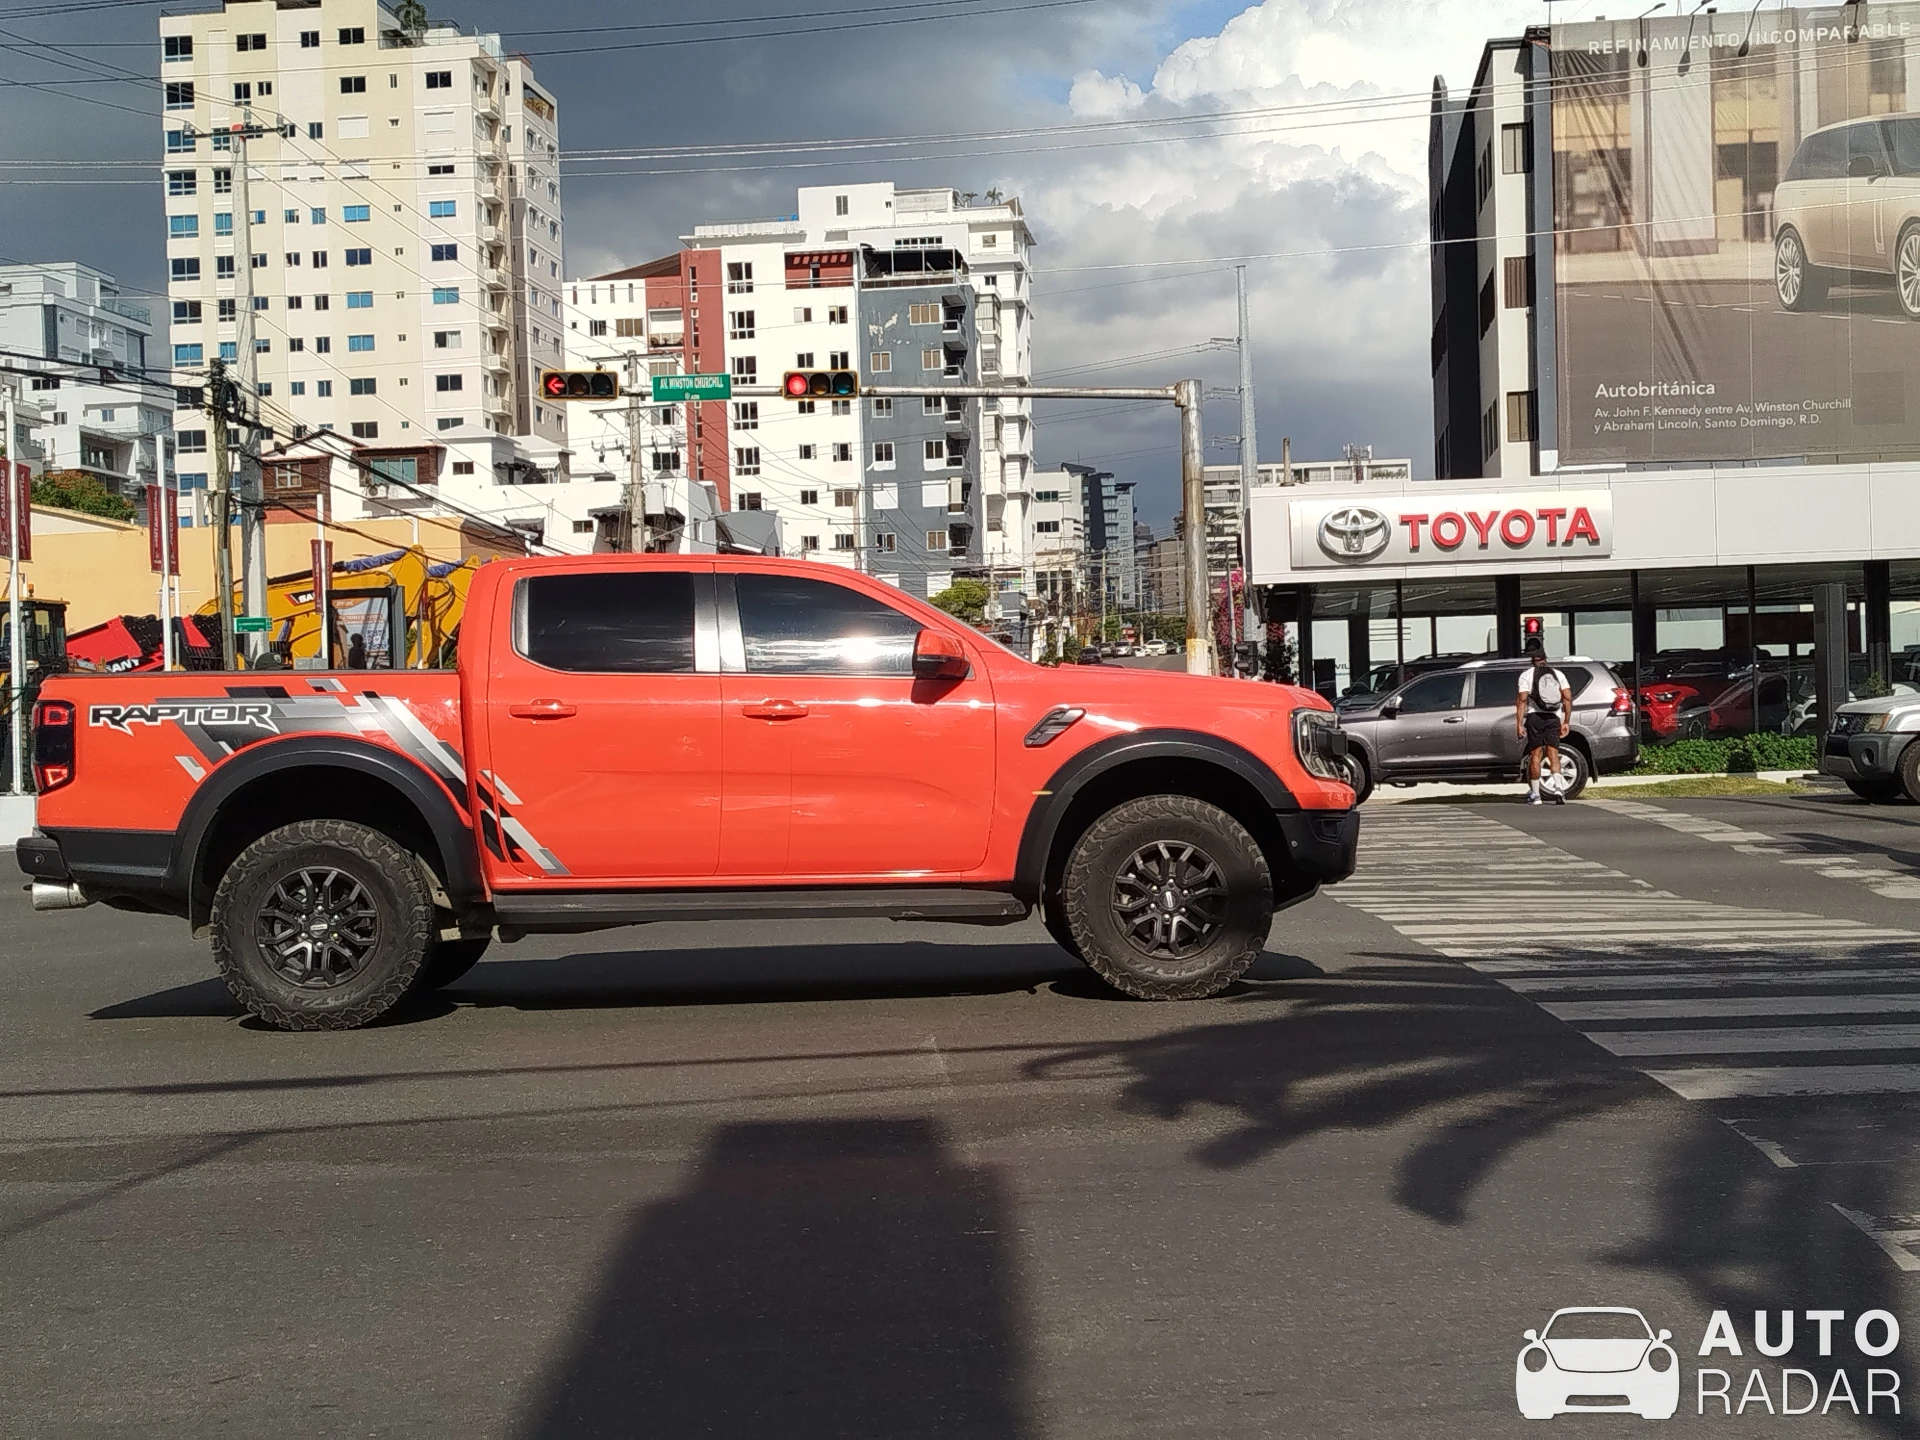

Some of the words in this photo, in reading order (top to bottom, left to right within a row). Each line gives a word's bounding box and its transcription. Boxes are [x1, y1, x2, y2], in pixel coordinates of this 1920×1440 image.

[1588, 33, 1740, 55] REFINAMIENTO
[1749, 22, 1911, 45] INCOMPARABLE
[669, 377, 693, 389] WINSTON
[694, 377, 724, 388] CHURCHILL
[1595, 381, 1715, 398] Autobritánica
[1594, 408, 1611, 418] Av.
[1613, 407, 1640, 417] John
[1643, 406, 1652, 416] F.
[1654, 404, 1702, 417] Kennedy
[1704, 405, 1733, 415] entre
[1735, 403, 1752, 414] Av.
[1754, 402, 1800, 413] Winston
[1802, 398, 1852, 411] Churchill
[1594, 424, 1601, 434] y
[1603, 421, 1654, 431] Abraham
[1658, 419, 1701, 430] Lincoln,
[1704, 418, 1737, 429] Santo
[1740, 416, 1797, 428] Domingo,
[1799, 414, 1822, 424] R.D.
[1399, 507, 1600, 550] TOYOTA
[89, 703, 281, 737] RAPTOR
